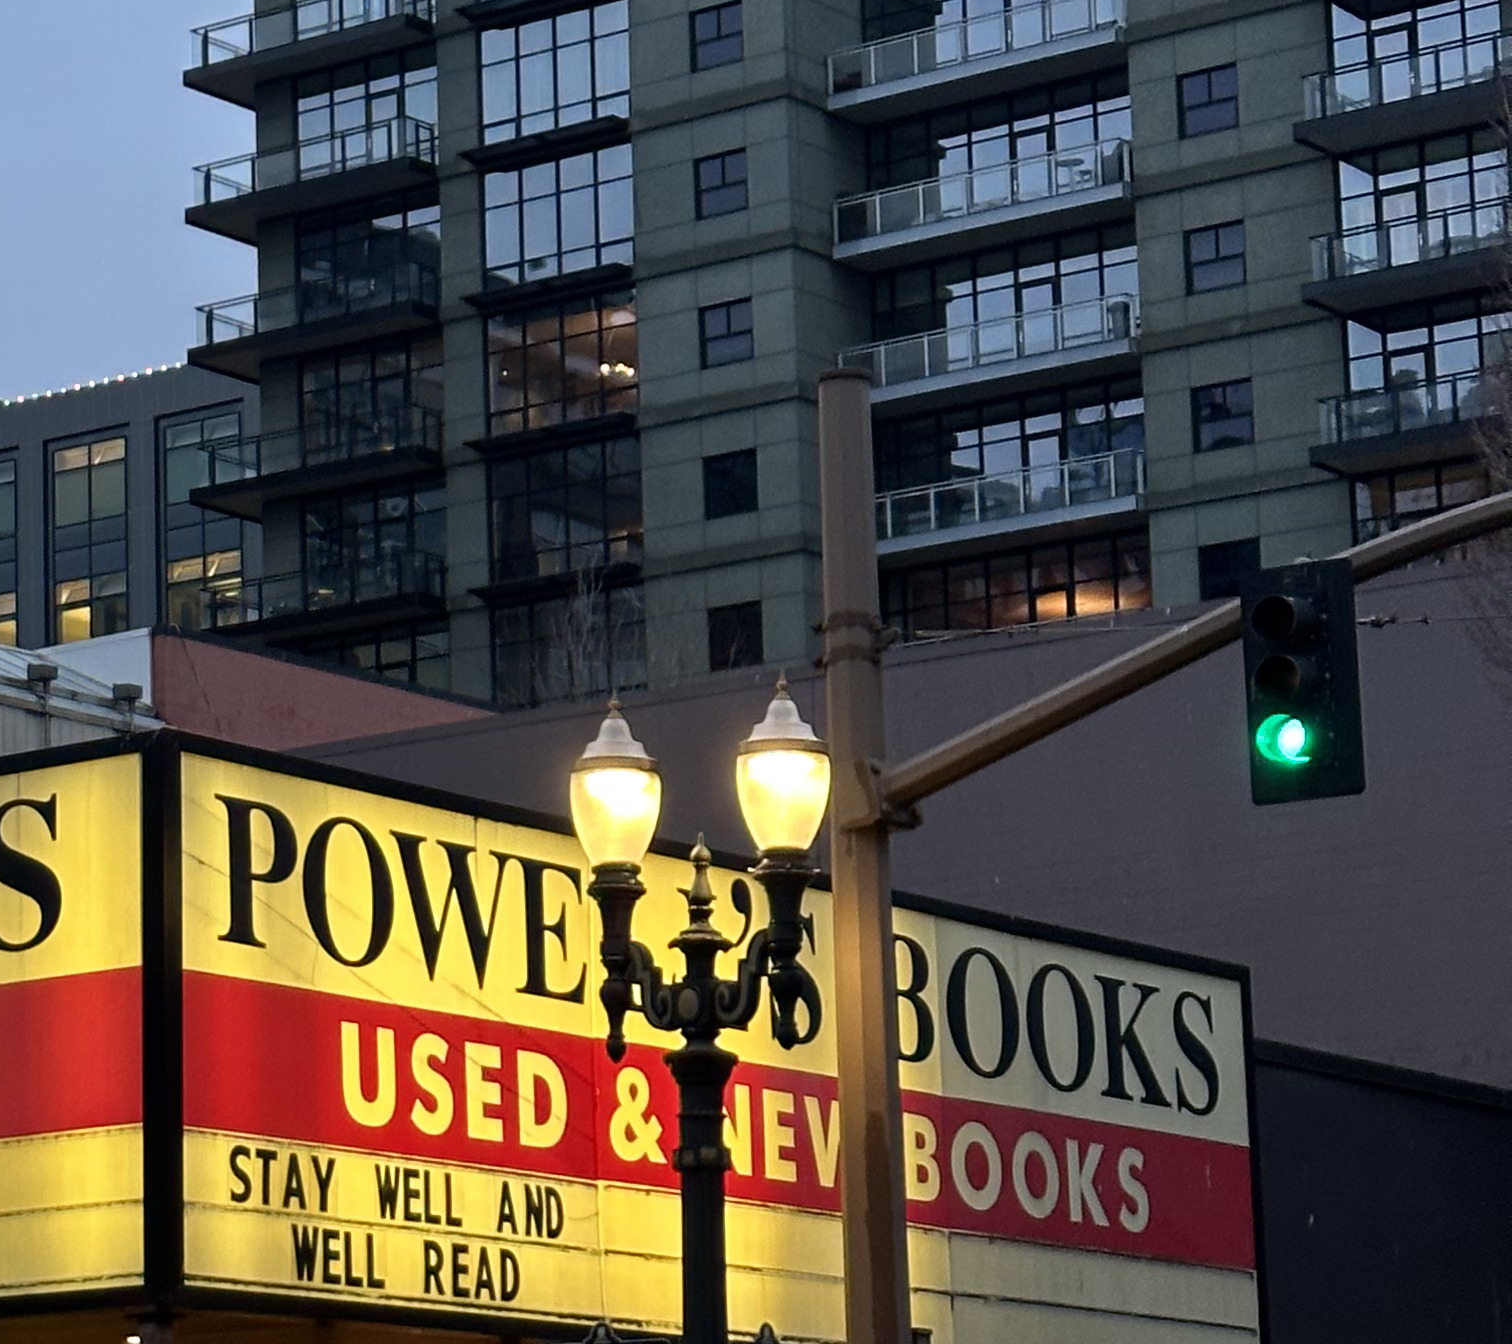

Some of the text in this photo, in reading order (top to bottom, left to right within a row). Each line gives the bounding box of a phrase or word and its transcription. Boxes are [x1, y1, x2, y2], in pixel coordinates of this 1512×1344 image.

[215, 793, 1219, 1116] POWE'S BOOKS
[229, 1145, 564, 1240] STAY WELL AND
[340, 1020, 569, 1148] USED
[609, 1066, 668, 1164] &
[903, 1112, 1151, 1234] BOOKS
[291, 1223, 520, 1302] WELL READ
